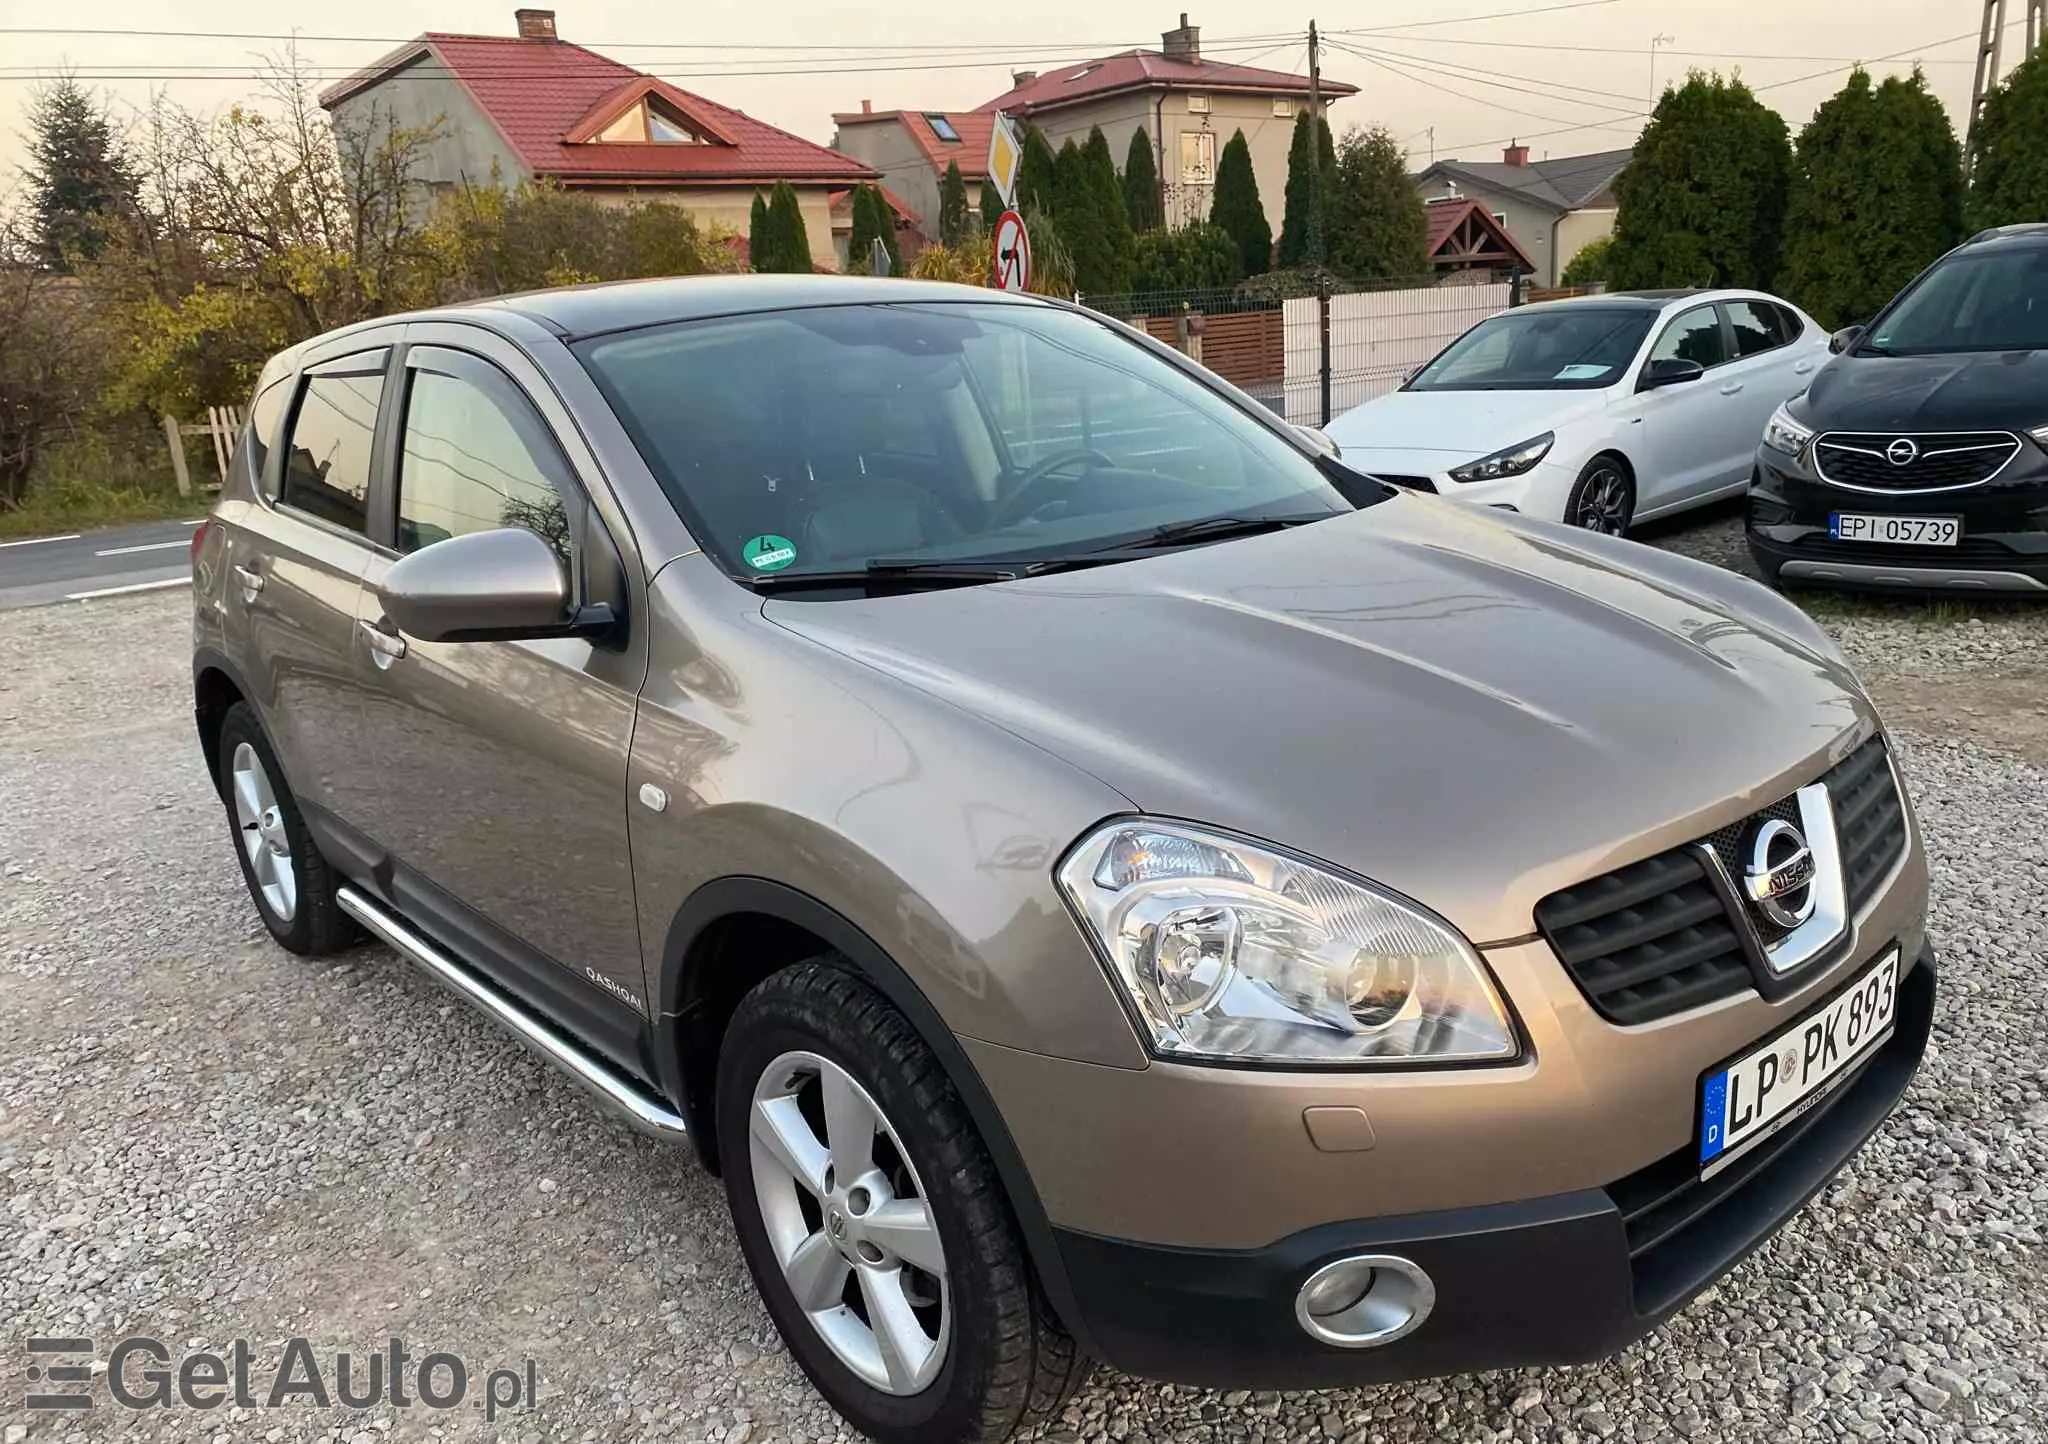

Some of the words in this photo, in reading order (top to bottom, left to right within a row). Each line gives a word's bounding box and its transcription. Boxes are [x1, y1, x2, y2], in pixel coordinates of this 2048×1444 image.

[1840, 517, 1875, 539] EPI
[1886, 520, 1955, 543] 05739
[760, 535, 775, 552] 4
[1728, 1052, 1779, 1136] LP
[1801, 1004, 1843, 1087] PK
[1847, 960, 1895, 1047] 893
[1708, 1124, 1718, 1144] D
